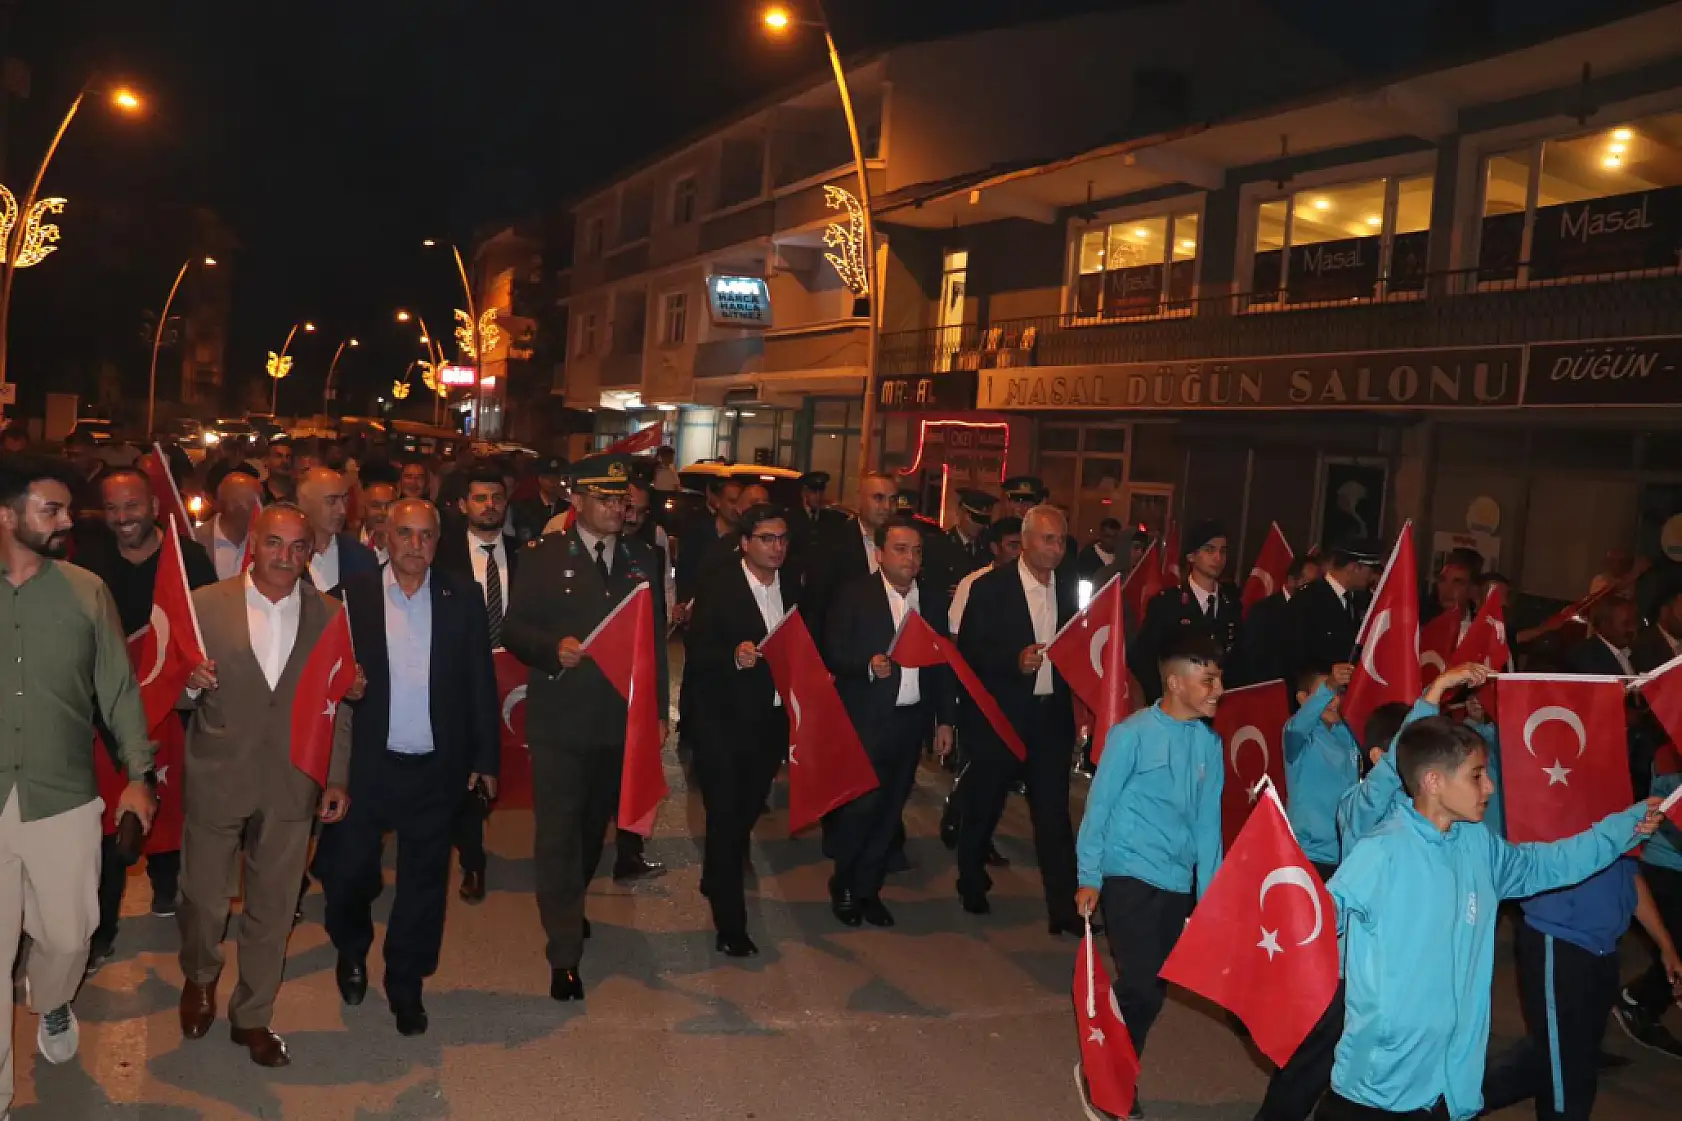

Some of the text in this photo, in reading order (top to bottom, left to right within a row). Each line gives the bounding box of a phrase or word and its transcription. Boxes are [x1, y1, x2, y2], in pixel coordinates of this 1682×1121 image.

[1559, 195, 1654, 243] Masal
[1303, 240, 1366, 277] Masal
[1006, 374, 1109, 406] MASAL
[1127, 364, 1262, 406] DÜĞÜN
[1289, 360, 1508, 404] SALONU
[1550, 346, 1660, 381] DÜĞÜN
